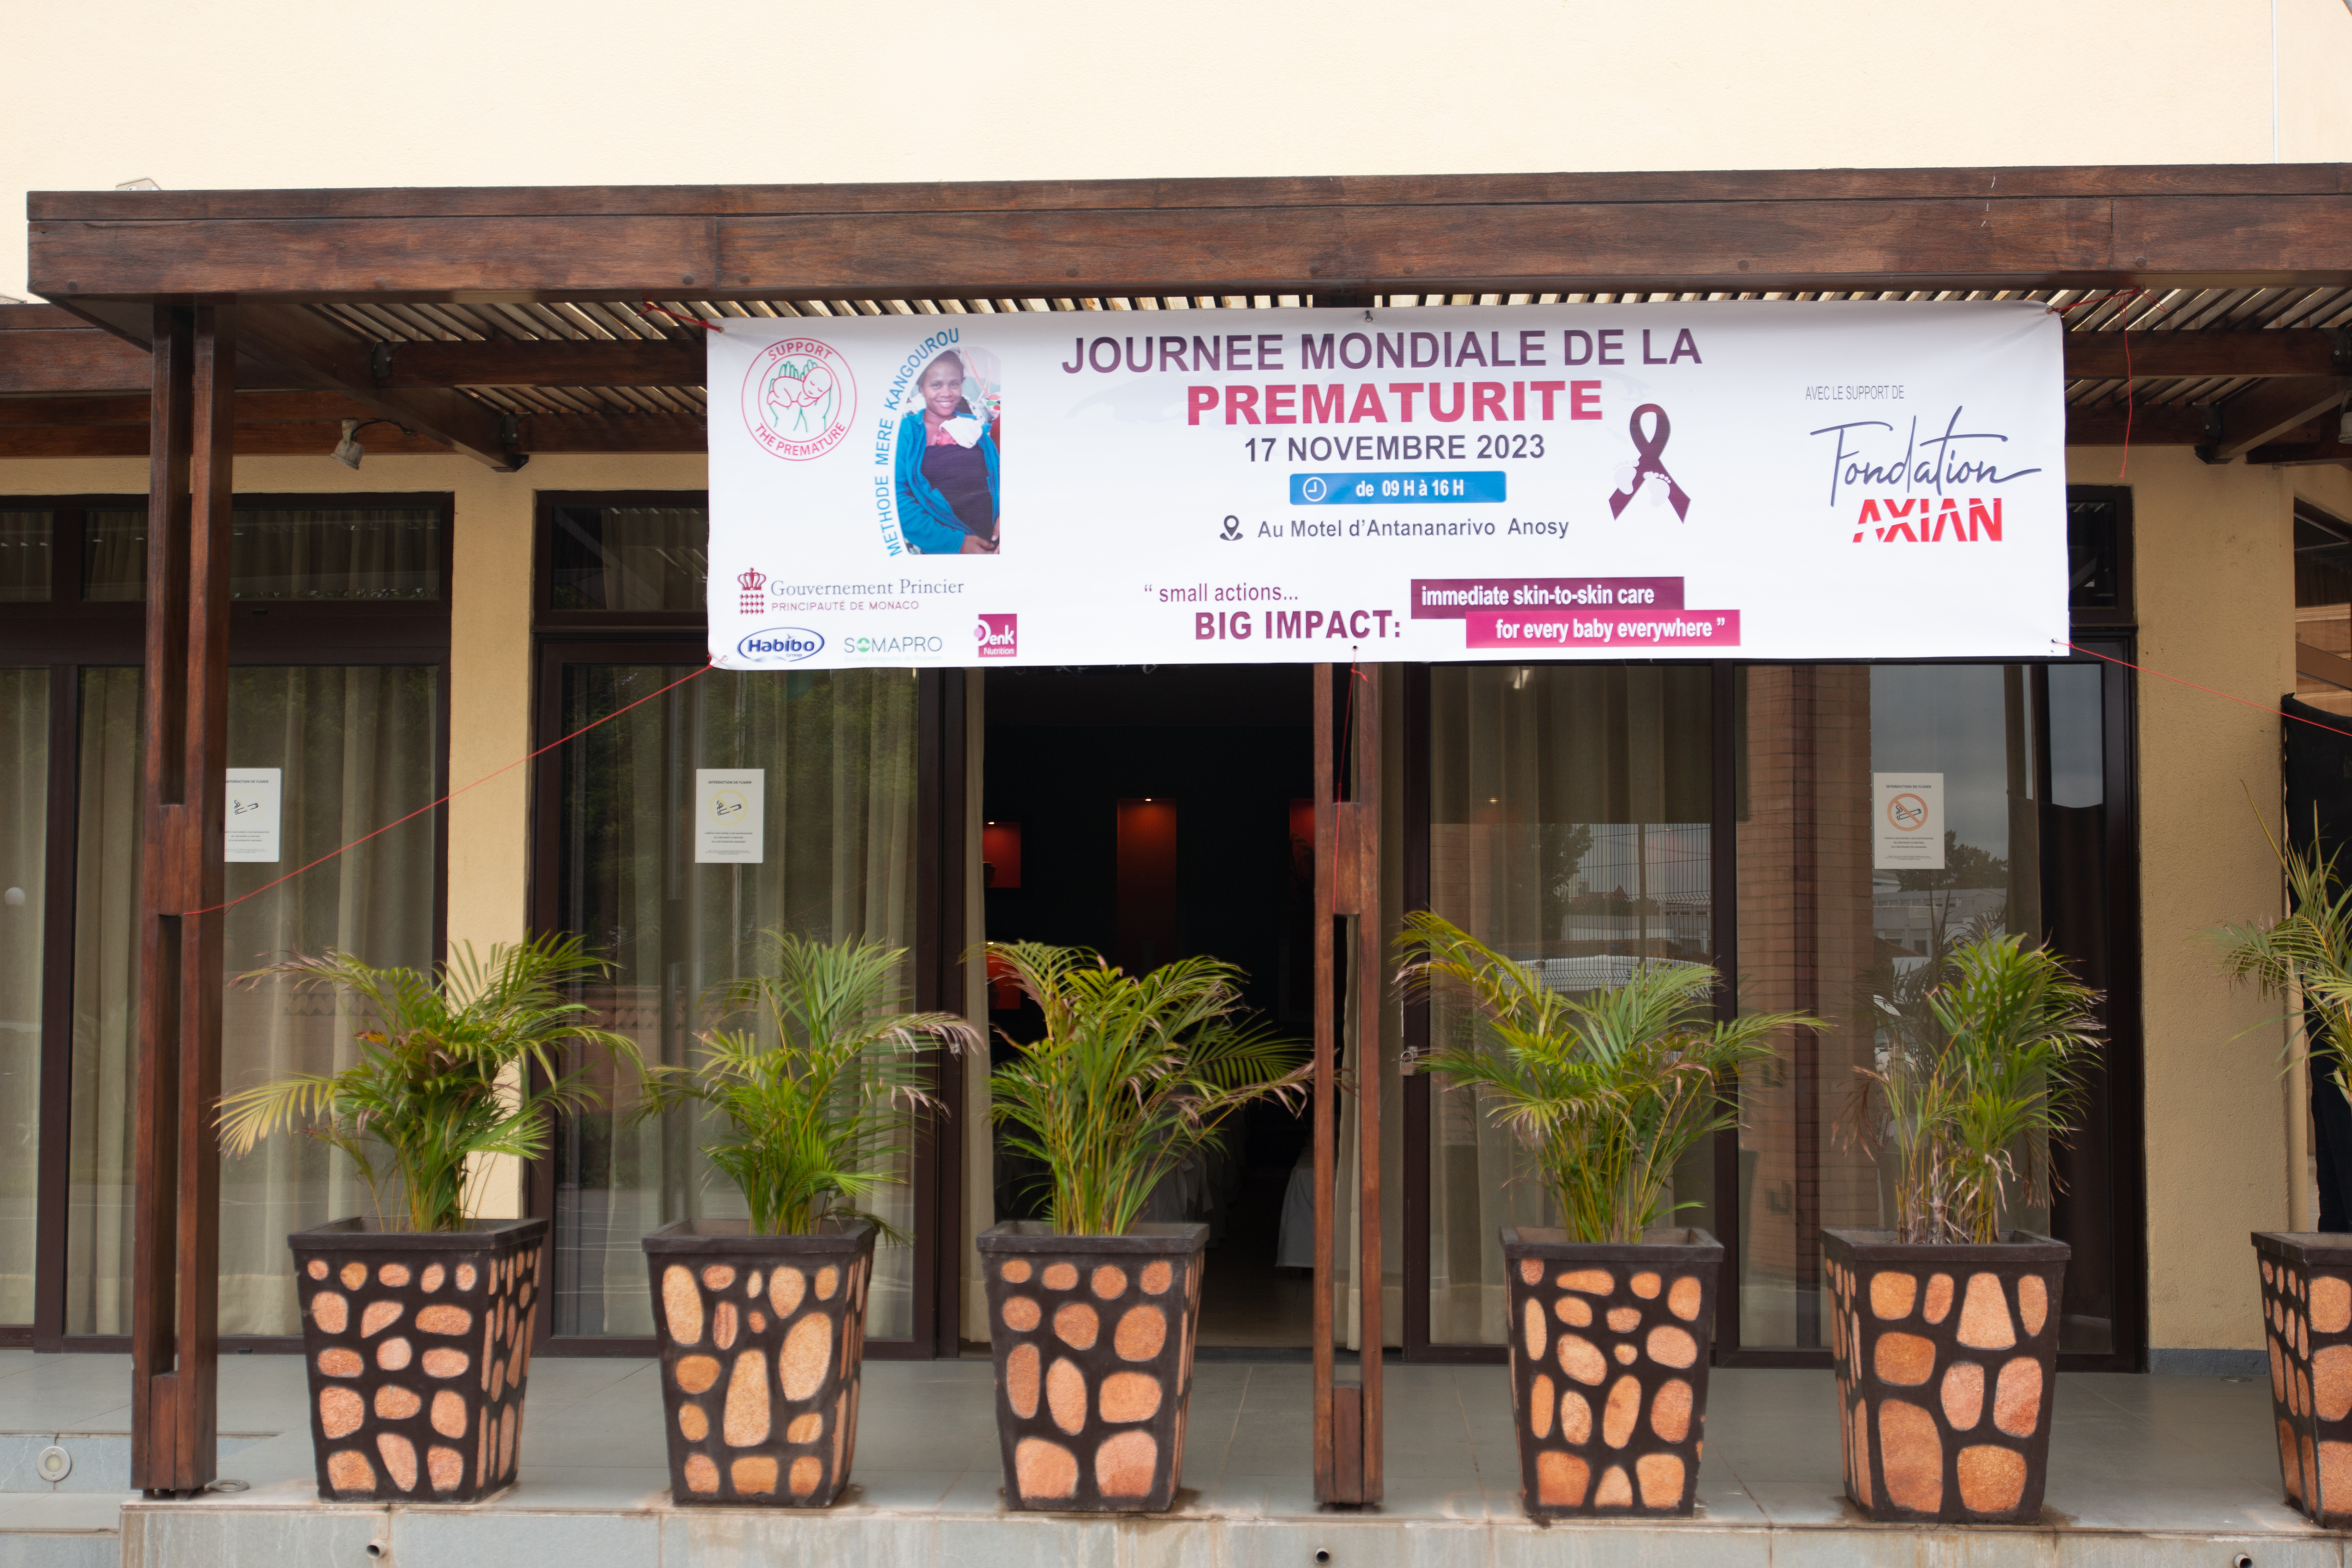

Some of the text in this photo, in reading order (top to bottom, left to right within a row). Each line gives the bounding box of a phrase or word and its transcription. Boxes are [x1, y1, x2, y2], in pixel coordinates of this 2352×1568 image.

[768, 341, 833, 361] SUPPORT
[1062, 328, 1703, 374] JOURNEE MONDIALE DE LA
[1187, 380, 1602, 426] PREMATURITE
[1805, 385, 1905, 401] AVEC LE SUPPORT DE
[755, 422, 846, 456] THE PREMATURE
[874, 328, 959, 557] METHODE MERE KANGOUROU
[1245, 434, 1546, 462] 17 NOVEMBRE 2023
[1810, 405, 2043, 507] Fondation
[1356, 479, 1464, 496] de 09 H à 16 H
[1258, 518, 1570, 539] Au Motel d’Antananarivo Anosy
[1852, 497, 2003, 543] AXIAN
[771, 579, 964, 596] Gouvernement Princier
[1159, 583, 1208, 602] small
[1214, 582, 1298, 600] actions...
[1421, 584, 1654, 606] immediate skin-to-skin care
[772, 600, 919, 611] PRINCIPAUTÉ DE MONACO
[977, 619, 1015, 646] Denk
[1195, 610, 1400, 640] BIG IMPACT:
[1495, 619, 1520, 639] for
[1524, 623, 1569, 643] every
[1573, 618, 1614, 643] baby
[1617, 617, 1712, 643] everywhere
[747, 638, 815, 652] Habibo
[983, 647, 1015, 655] Nutrition
